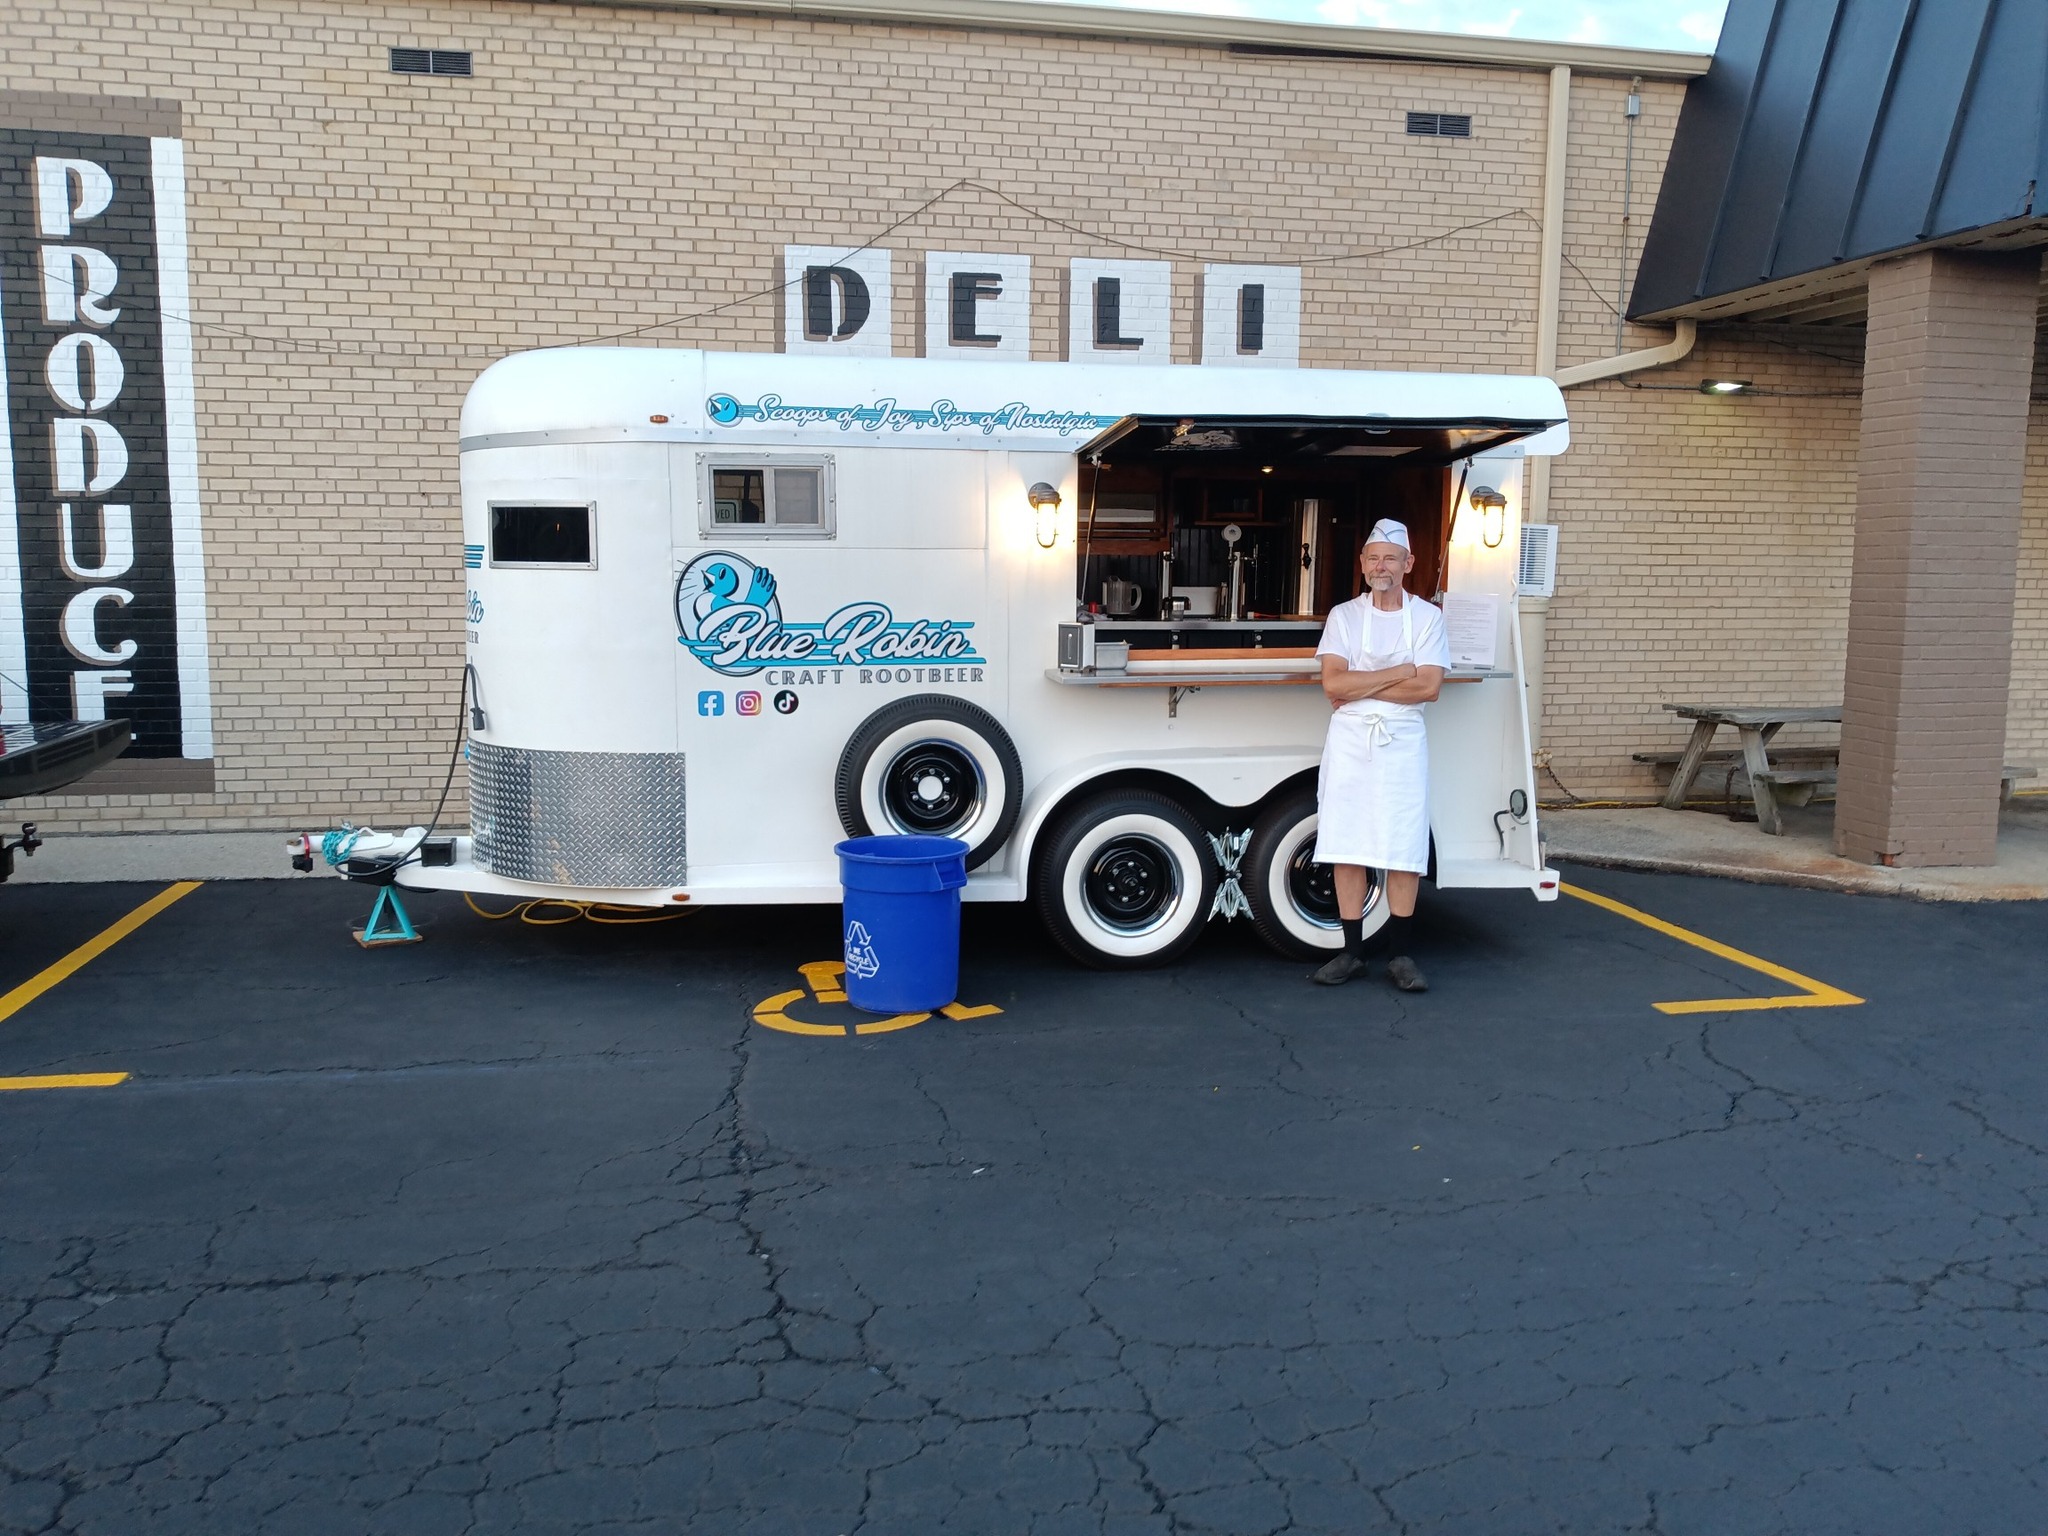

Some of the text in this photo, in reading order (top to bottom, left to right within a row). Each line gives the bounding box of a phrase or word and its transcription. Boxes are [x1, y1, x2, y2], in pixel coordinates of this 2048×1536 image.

[802, 265, 1265, 350] DELI
[754, 393, 832, 427] Scoops
[835, 404, 864, 430] of
[927, 399, 975, 431] Sips
[978, 408, 1005, 435] of
[1003, 402, 1099, 436] Nostalgia
[697, 602, 971, 666] Blue Robin
[765, 667, 984, 685] CRAFT ROOTBEER
